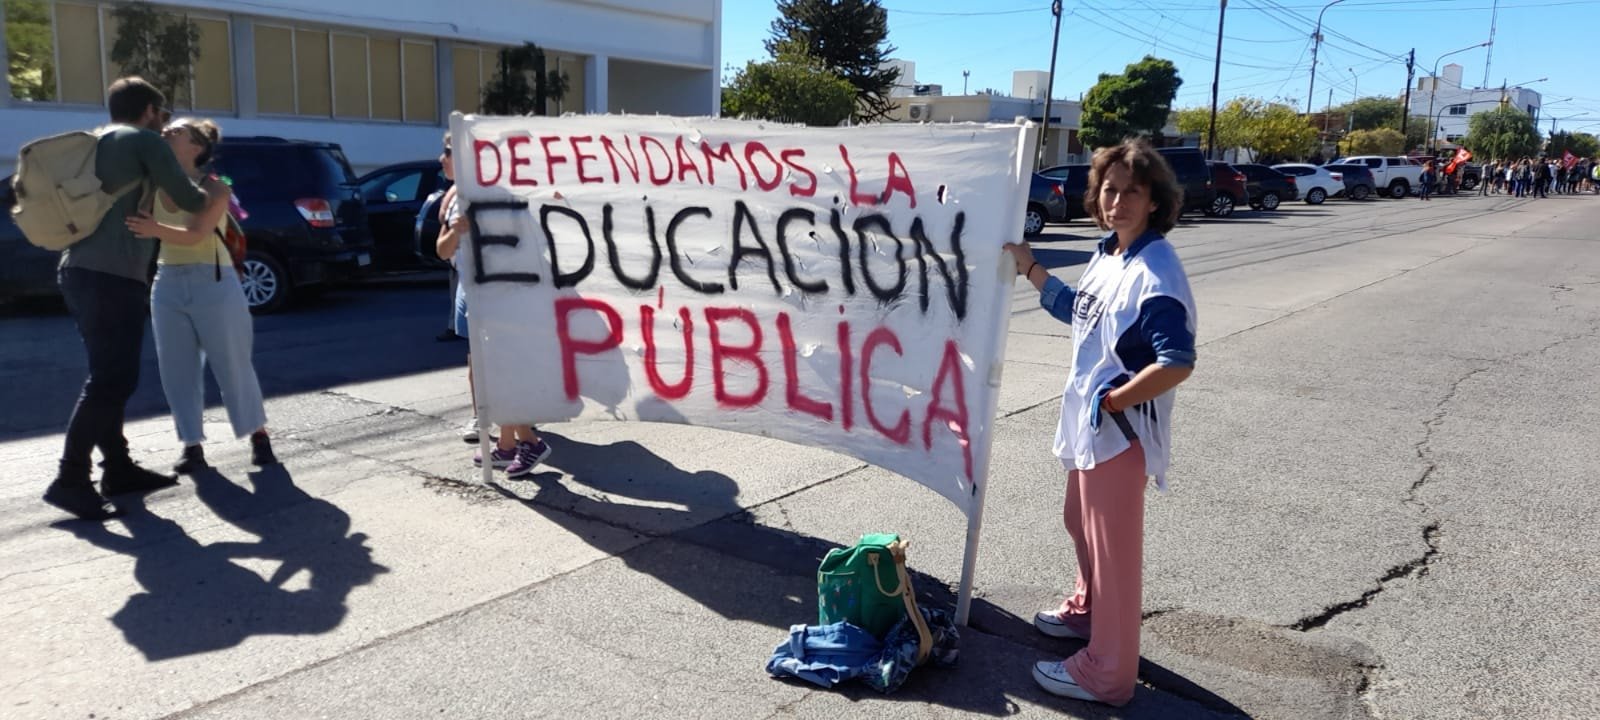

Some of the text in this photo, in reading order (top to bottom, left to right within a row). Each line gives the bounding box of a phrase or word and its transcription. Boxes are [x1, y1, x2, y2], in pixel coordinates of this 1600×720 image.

[473, 134, 917, 209] DEFENDAMOS LA
[554, 285, 973, 484] PÚBLICA
